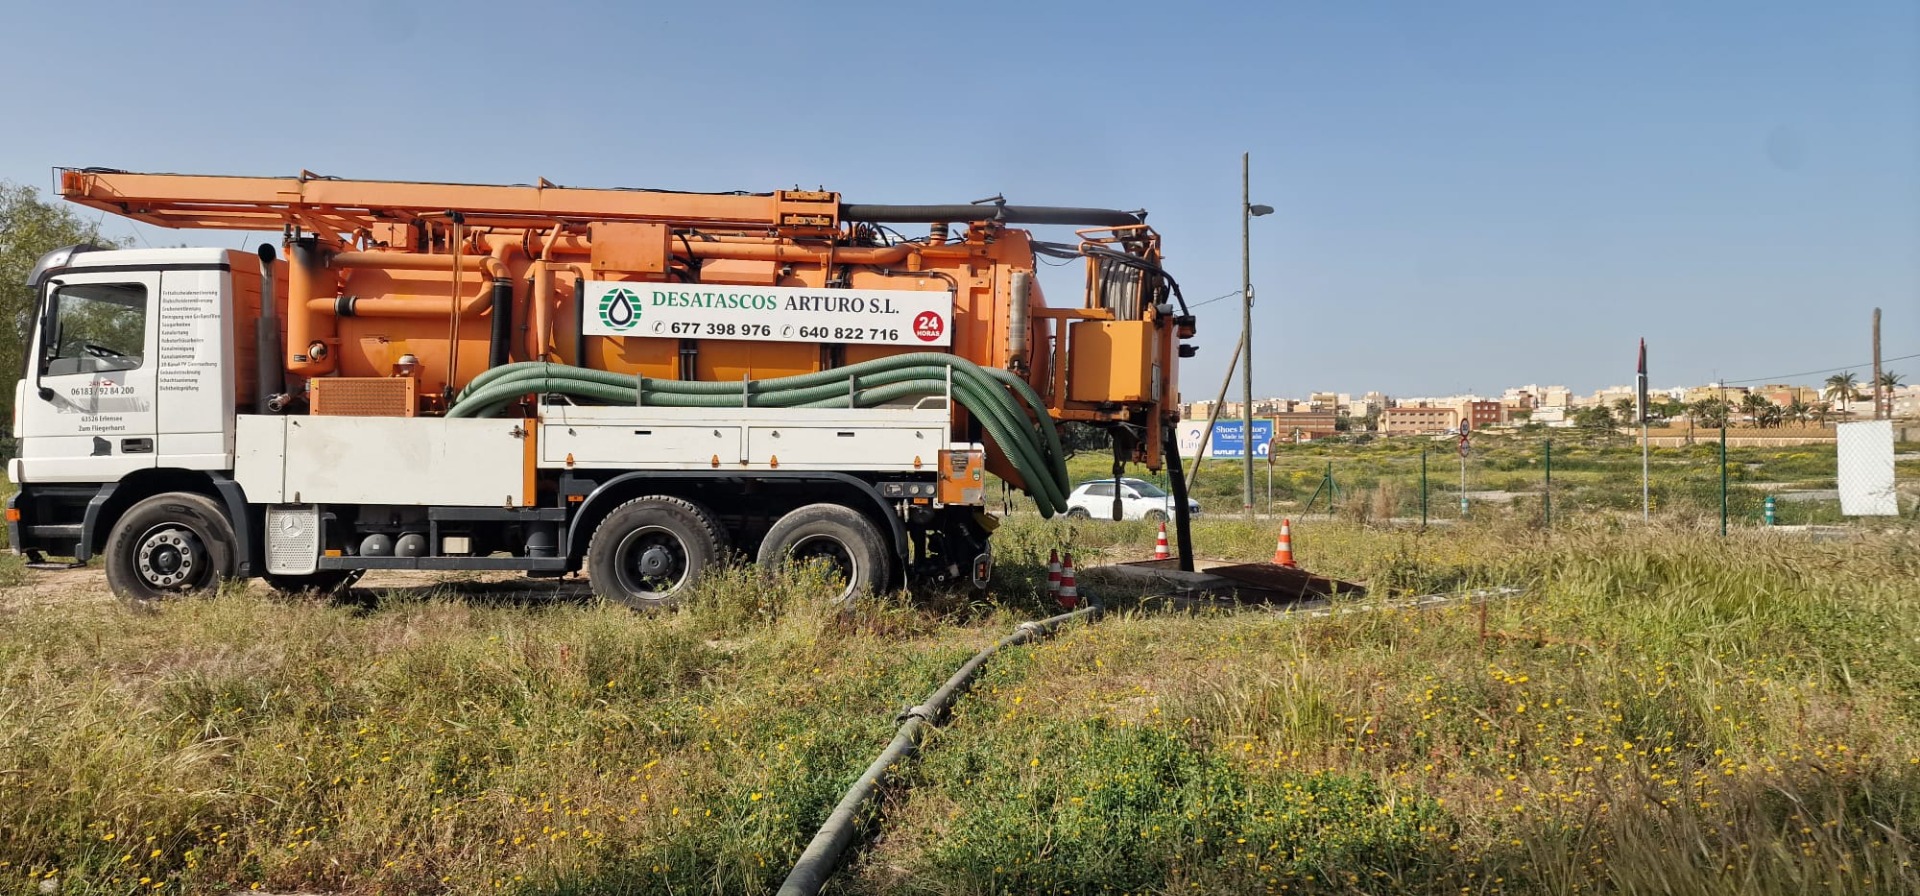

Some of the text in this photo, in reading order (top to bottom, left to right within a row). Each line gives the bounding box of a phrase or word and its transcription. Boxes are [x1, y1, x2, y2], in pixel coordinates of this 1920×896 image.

[652, 291, 900, 314] DESATASCOS ARTURO S.L.
[671, 322, 771, 337] 677 398 976
[918, 316, 939, 330] 24
[799, 326, 899, 341] 640 822 716
[71, 387, 93, 396] 06183
[99, 387, 108, 395] 92
[110, 387, 119, 395] 84
[121, 386, 135, 395] 200
[91, 424, 126, 432] Fliegerhorst
[1215, 425, 1267, 434] Shoes Ftory
